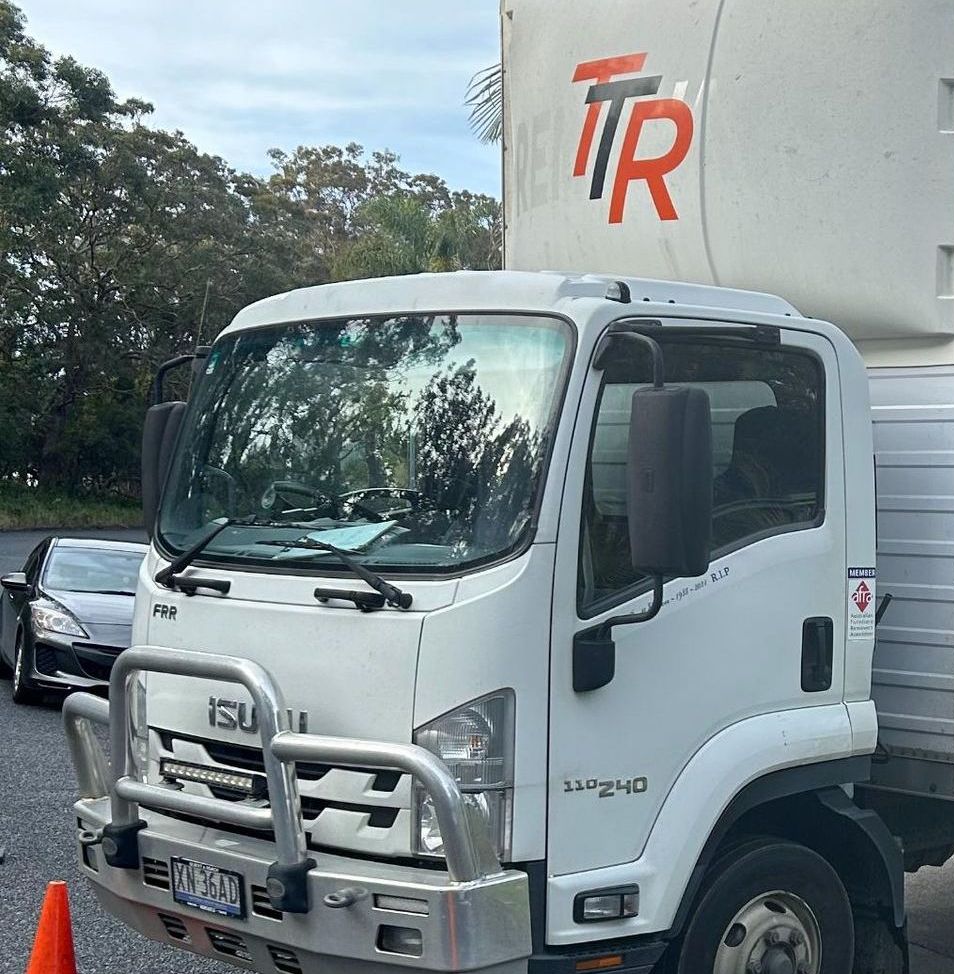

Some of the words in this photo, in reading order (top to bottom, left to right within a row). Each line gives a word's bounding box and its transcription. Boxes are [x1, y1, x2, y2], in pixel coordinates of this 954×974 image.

[571, 52, 694, 224] TTR
[849, 568, 875, 577] MEMBER
[152, 603, 178, 620] FRR
[208, 697, 308, 735] ISUU
[564, 779, 597, 793] 110
[598, 776, 647, 799] 240
[175, 863, 196, 895] XN
[200, 868, 238, 904] 36AD
